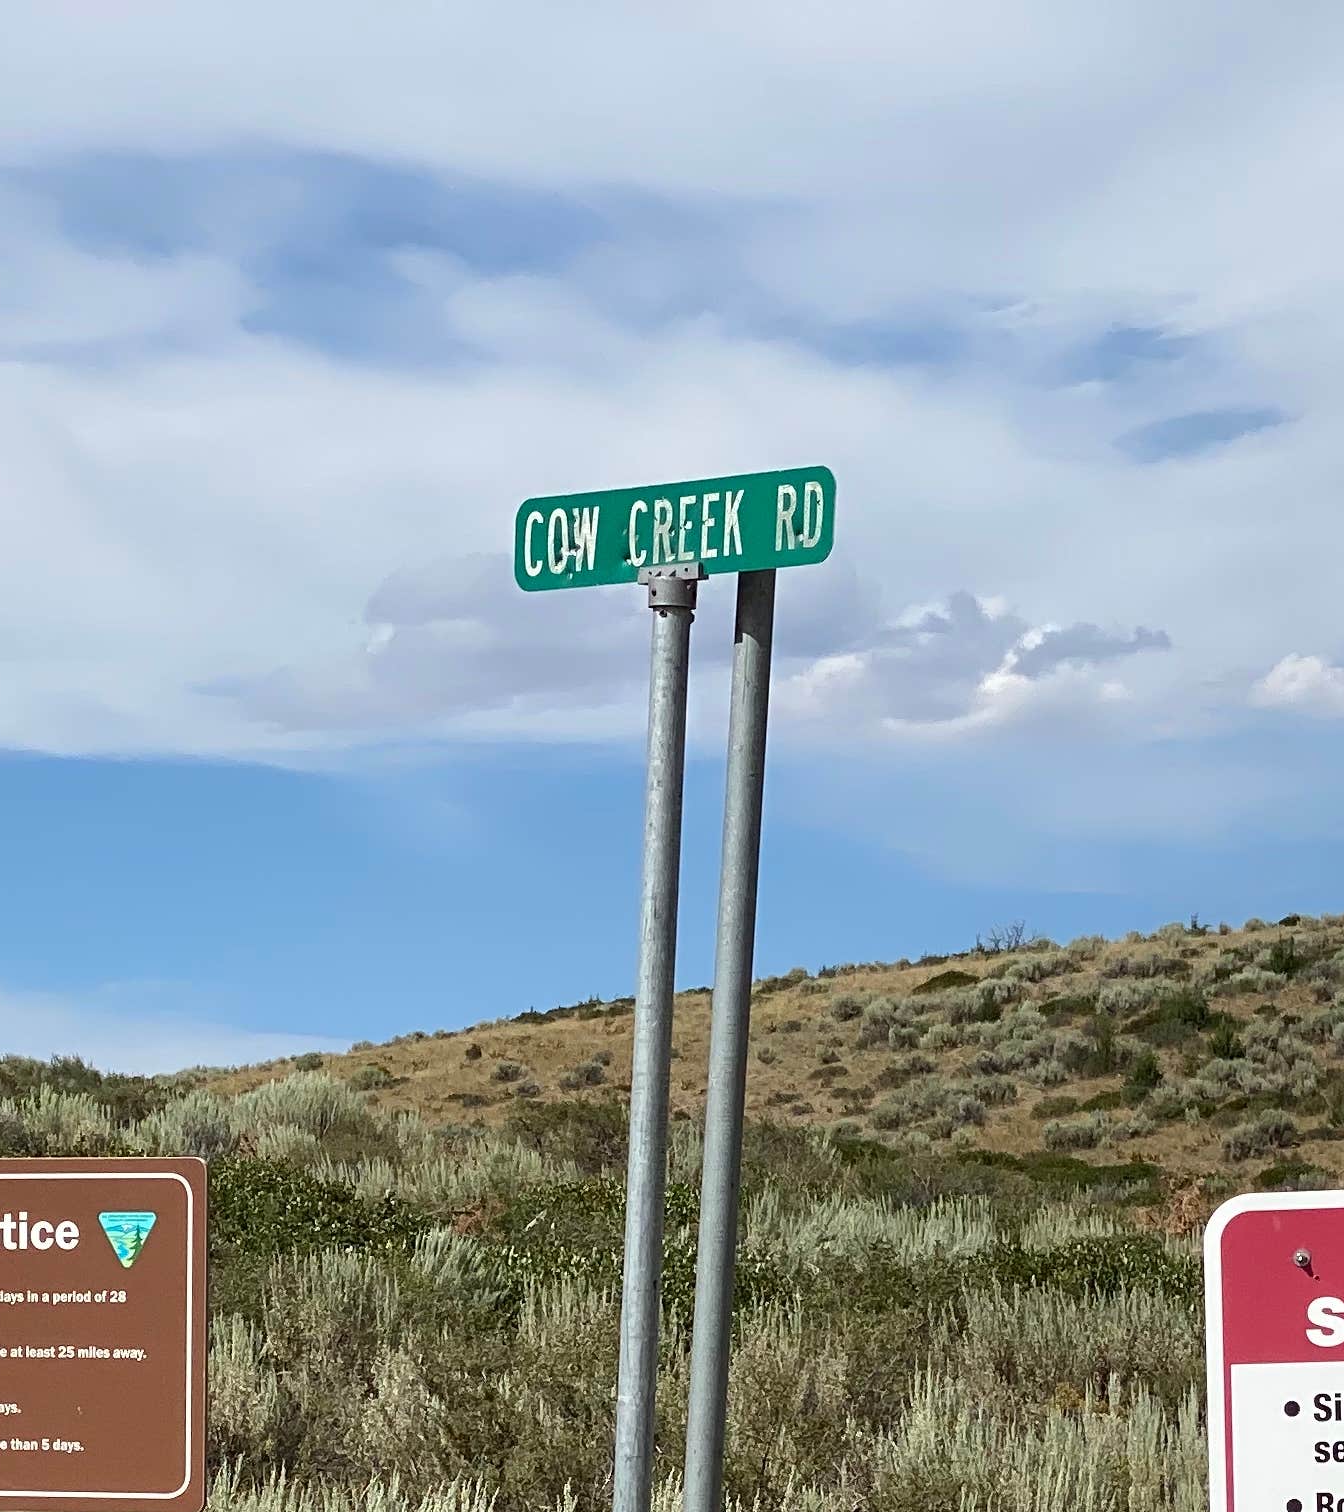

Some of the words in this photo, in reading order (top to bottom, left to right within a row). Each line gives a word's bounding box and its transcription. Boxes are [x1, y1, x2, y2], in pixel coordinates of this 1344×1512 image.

[524, 506, 600, 577] COW
[628, 489, 745, 567] CREEK
[775, 481, 824, 552] RD
[26, 1290, 39, 1303] in
[52, 1290, 92, 1306] period
[93, 1289, 108, 1303] of
[109, 1290, 127, 1303] 28
[9, 1345, 24, 1358] at
[25, 1345, 56, 1359] least
[57, 1345, 75, 1359] 25
[77, 1345, 111, 1359] miles
[112, 1348, 147, 1362] away.
[9, 1437, 39, 1451] than
[41, 1438, 50, 1451] 5
[52, 1438, 85, 1454] days.
